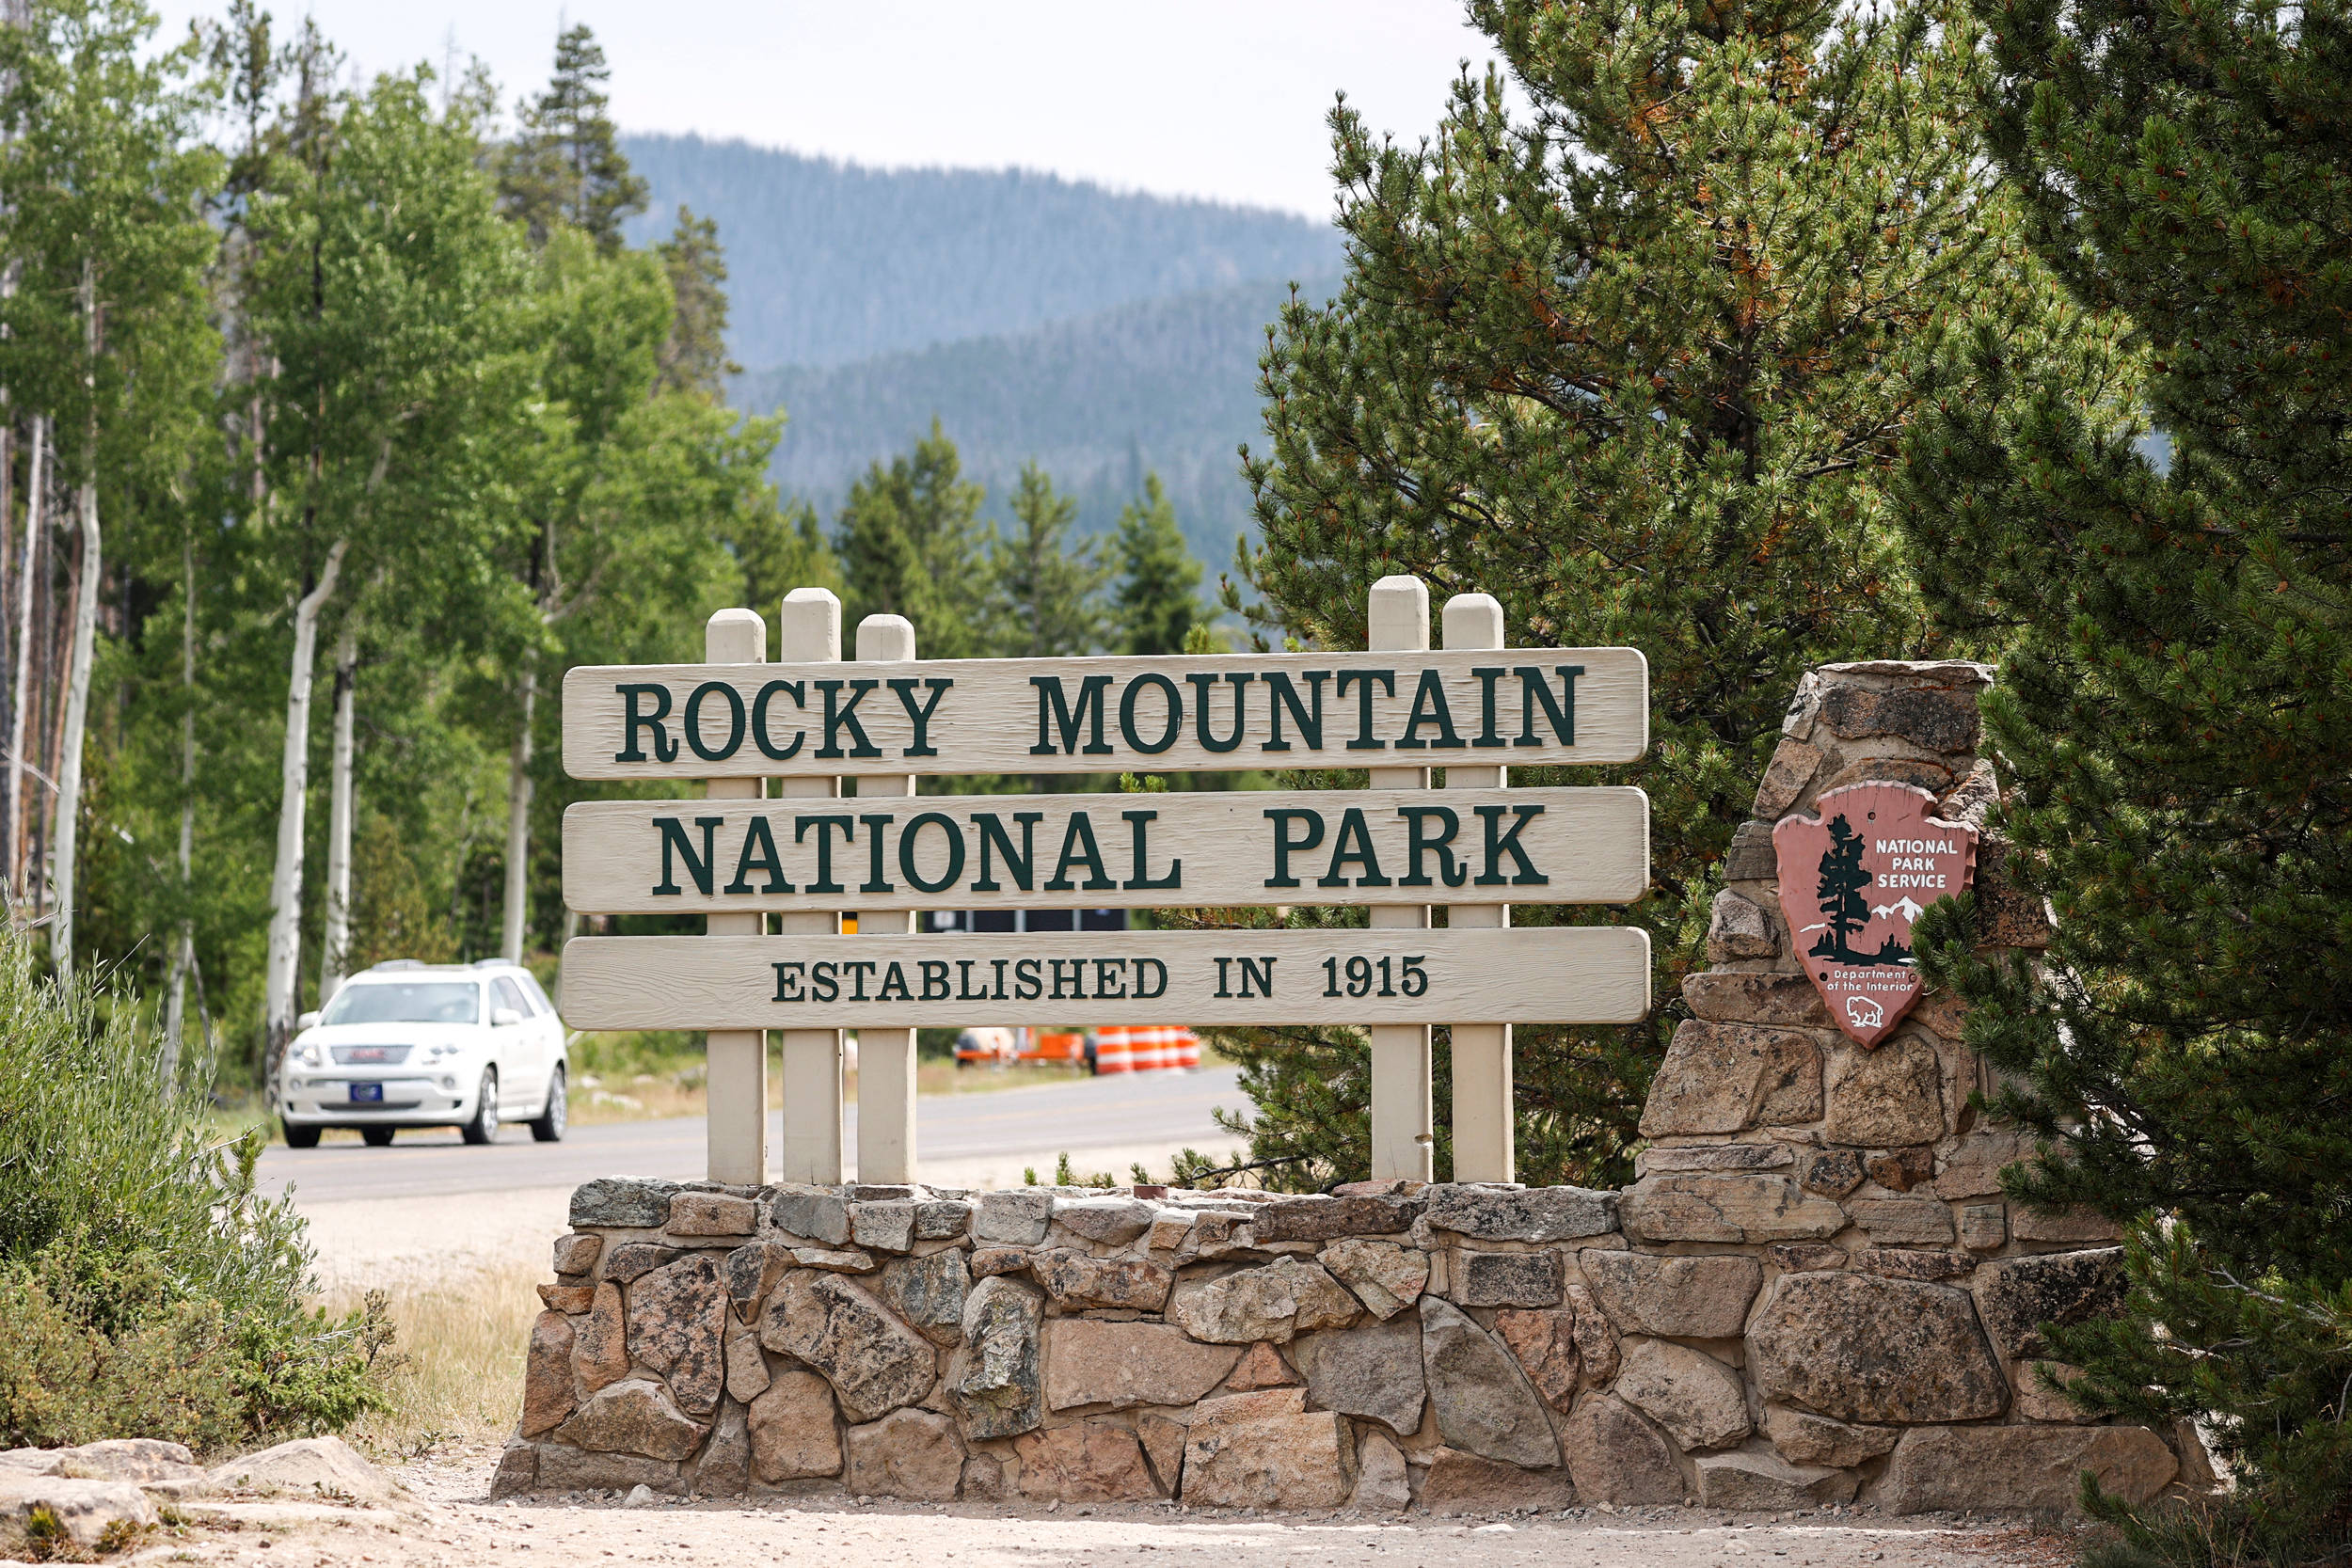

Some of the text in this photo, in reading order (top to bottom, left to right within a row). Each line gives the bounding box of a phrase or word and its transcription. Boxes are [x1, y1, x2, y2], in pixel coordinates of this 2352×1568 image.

[614, 665, 1585, 763] ROCKY MOUNTAIN
[652, 804, 1549, 896] NATIONAL PARK
[1876, 838, 1958, 855] NATIONAL
[1892, 857, 1935, 871] PARK
[1877, 873, 1947, 889] SERVICE
[771, 955, 1428, 1003] ESTABLISHED IN 1915
[1834, 969, 1906, 981] Department
[1827, 981, 1914, 992] of the Interior
